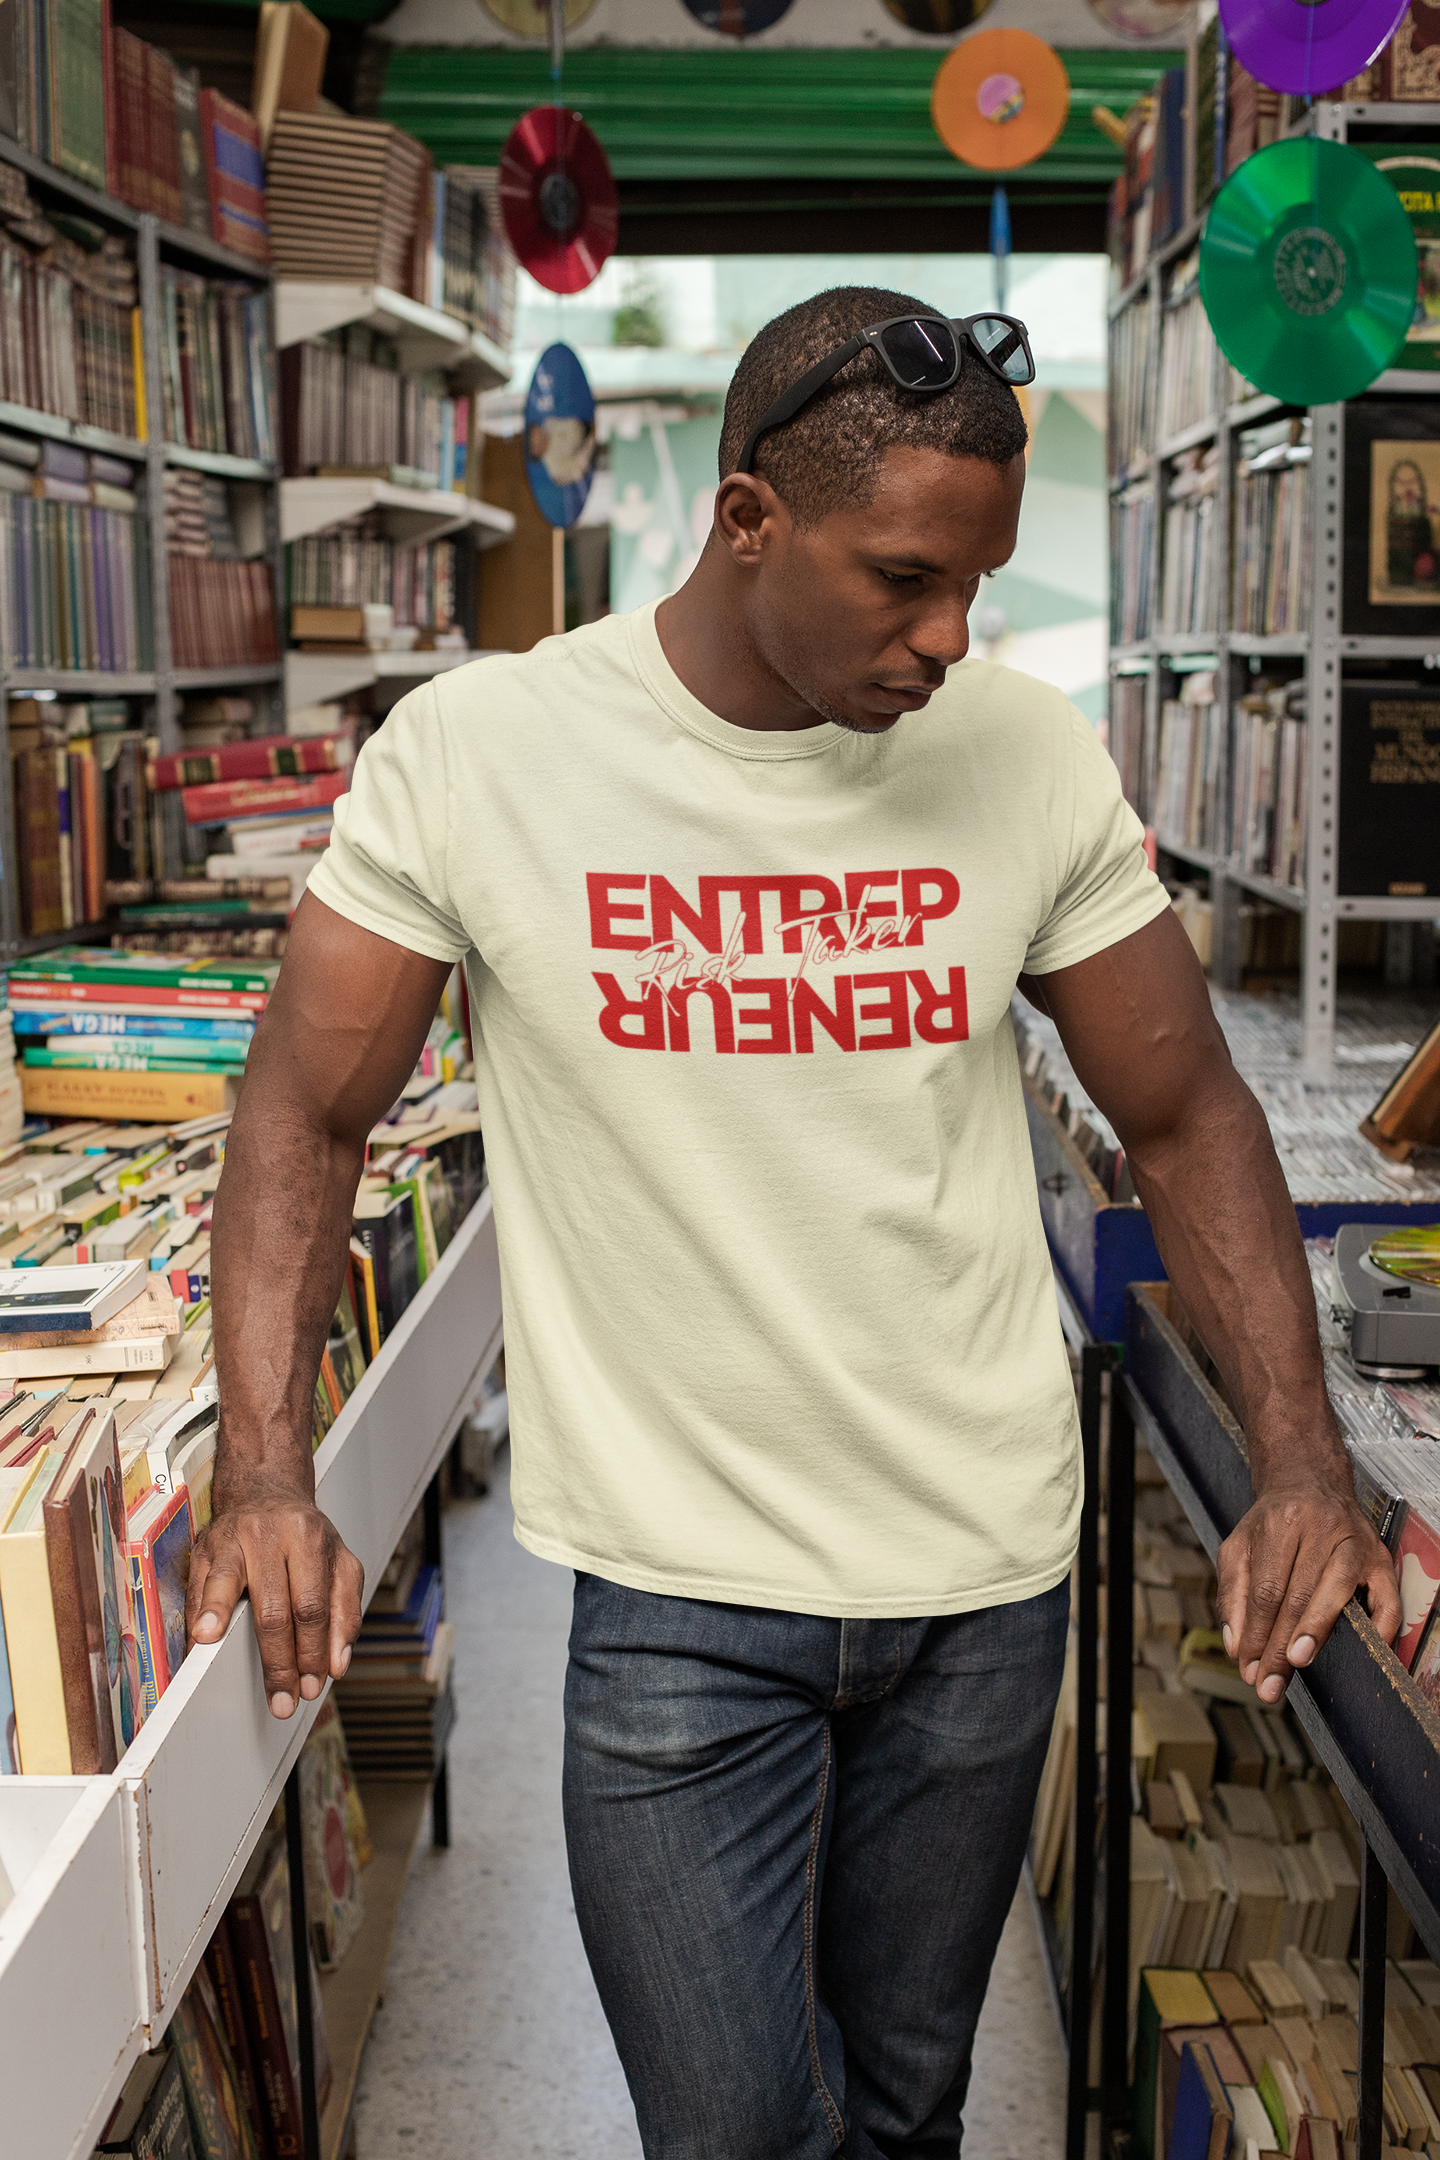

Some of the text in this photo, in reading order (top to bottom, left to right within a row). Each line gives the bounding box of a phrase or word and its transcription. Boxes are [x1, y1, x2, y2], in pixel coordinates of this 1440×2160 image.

[586, 867, 961, 955] ENTREP
[634, 883, 923, 1018] Risk Taker
[591, 965, 970, 1055] RENEUR
